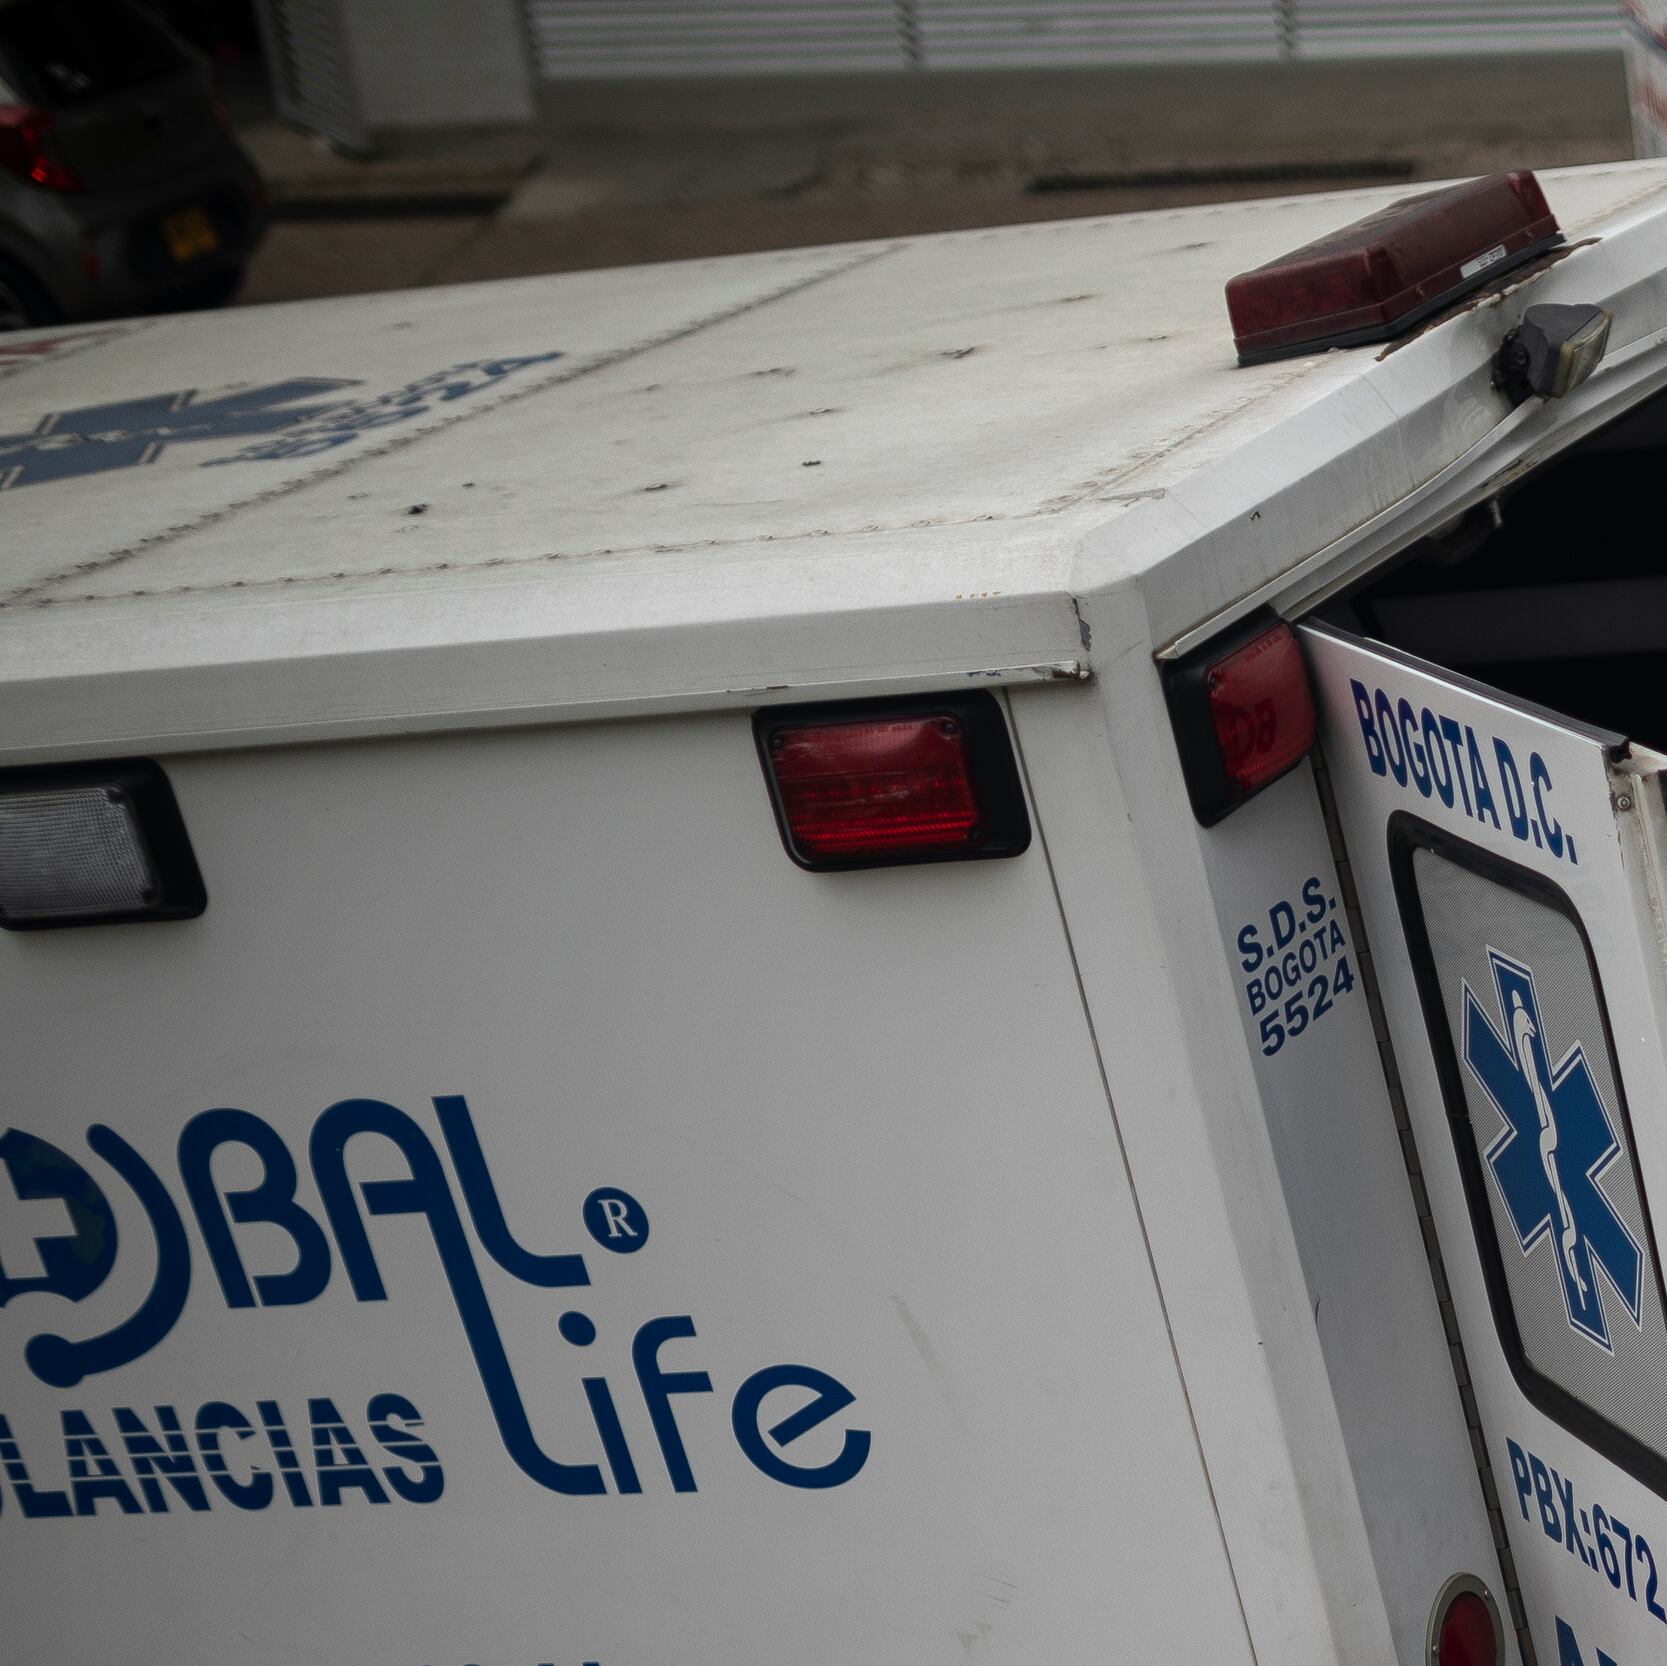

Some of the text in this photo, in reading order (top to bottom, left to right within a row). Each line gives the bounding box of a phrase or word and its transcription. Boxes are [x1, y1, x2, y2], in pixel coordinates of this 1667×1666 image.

[1350, 678, 1578, 865] BOGOTA D.C.
[1237, 876, 1337, 973] S.D.S.
[1246, 918, 1346, 1016] BOGOTA
[1258, 955, 1354, 1056] 5524
[0, 1394, 445, 1519] LANCIAS
[1506, 1437, 1667, 1625] PBX:672
